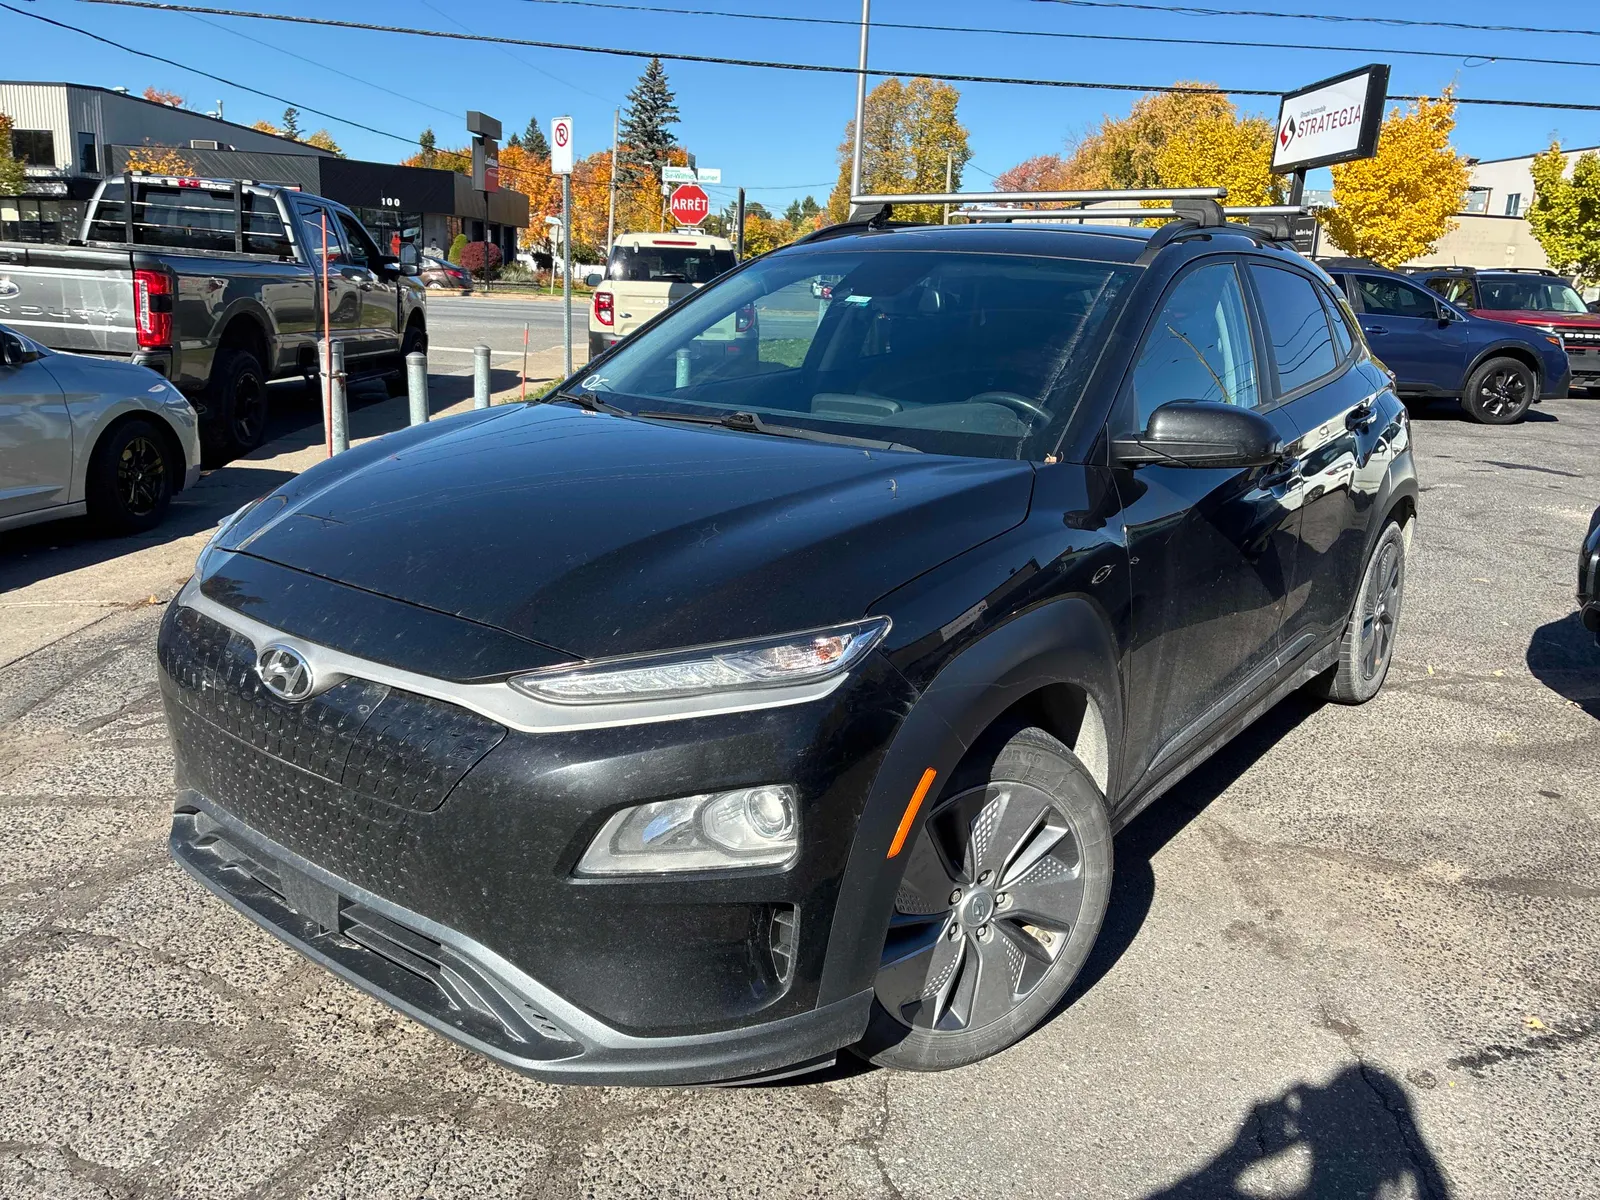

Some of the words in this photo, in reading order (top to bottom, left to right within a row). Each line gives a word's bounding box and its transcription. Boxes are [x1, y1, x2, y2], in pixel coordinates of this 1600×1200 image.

[1297, 104, 1361, 138] STRATEGIA
[381, 197, 400, 207] 100
[673, 197, 707, 211] ARRÊT
[20, 305, 119, 321] DUTY
